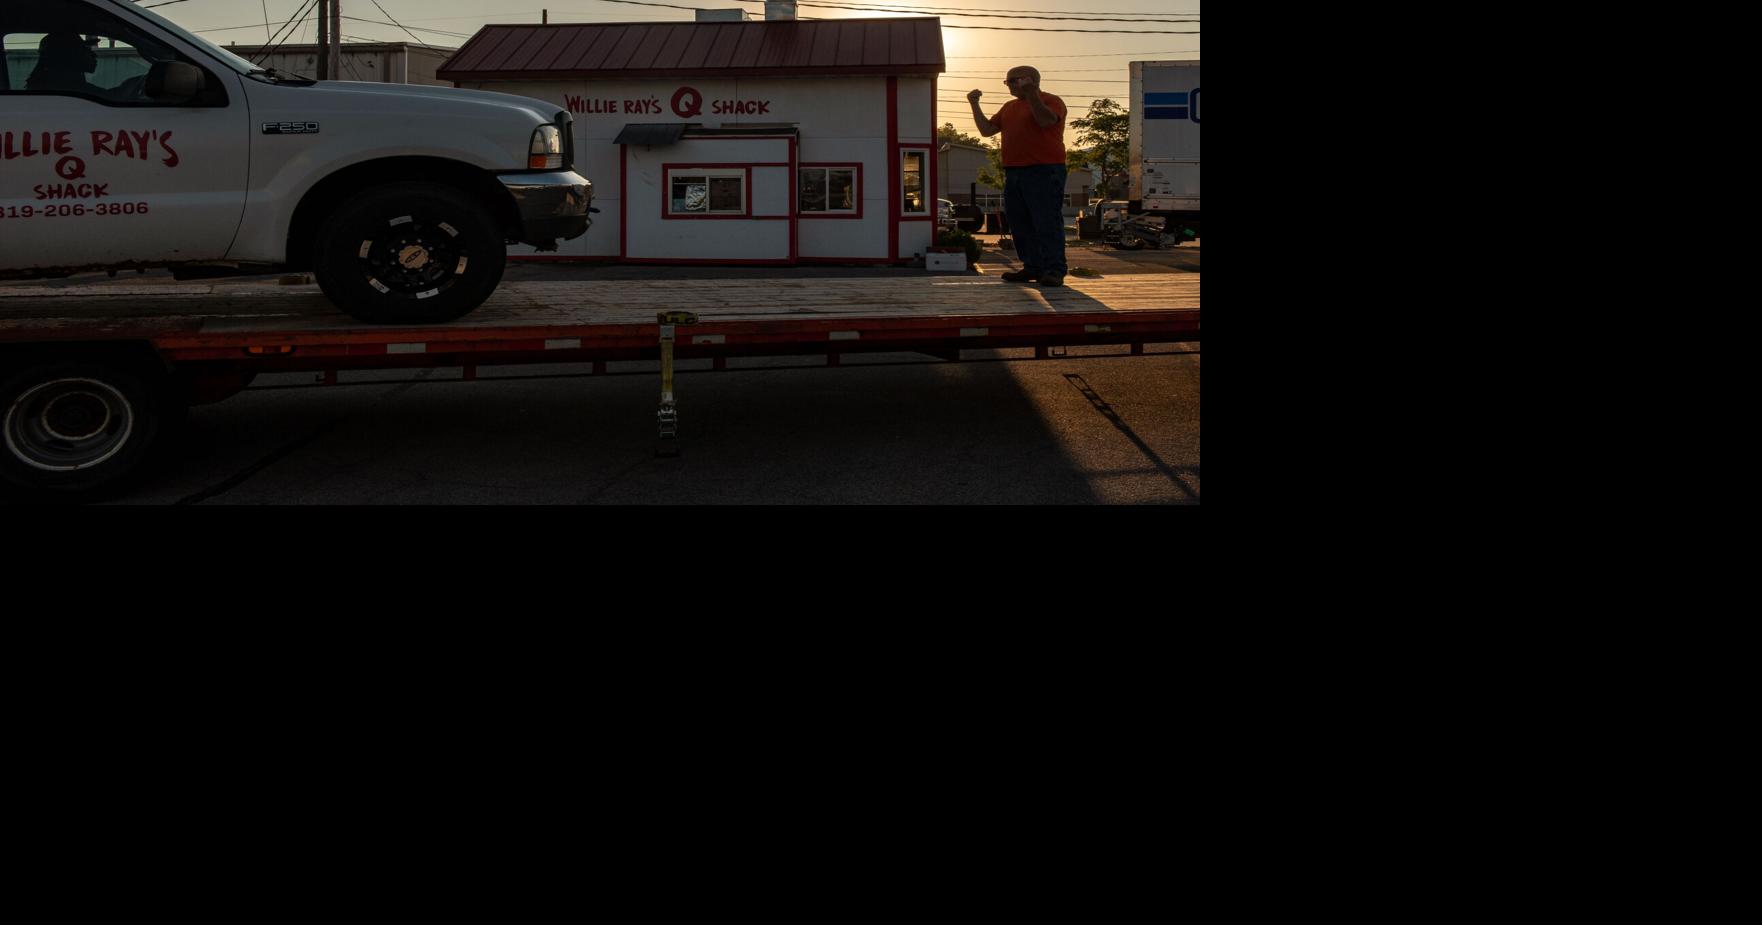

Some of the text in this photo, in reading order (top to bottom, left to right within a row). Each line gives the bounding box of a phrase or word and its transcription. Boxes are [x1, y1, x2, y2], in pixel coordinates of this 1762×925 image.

[564, 86, 770, 118] WILLIE RAY'S Q SHACK
[0, 129, 179, 167] LLIE RAY'S
[55, 156, 85, 179] Q
[34, 183, 109, 200] SHACK
